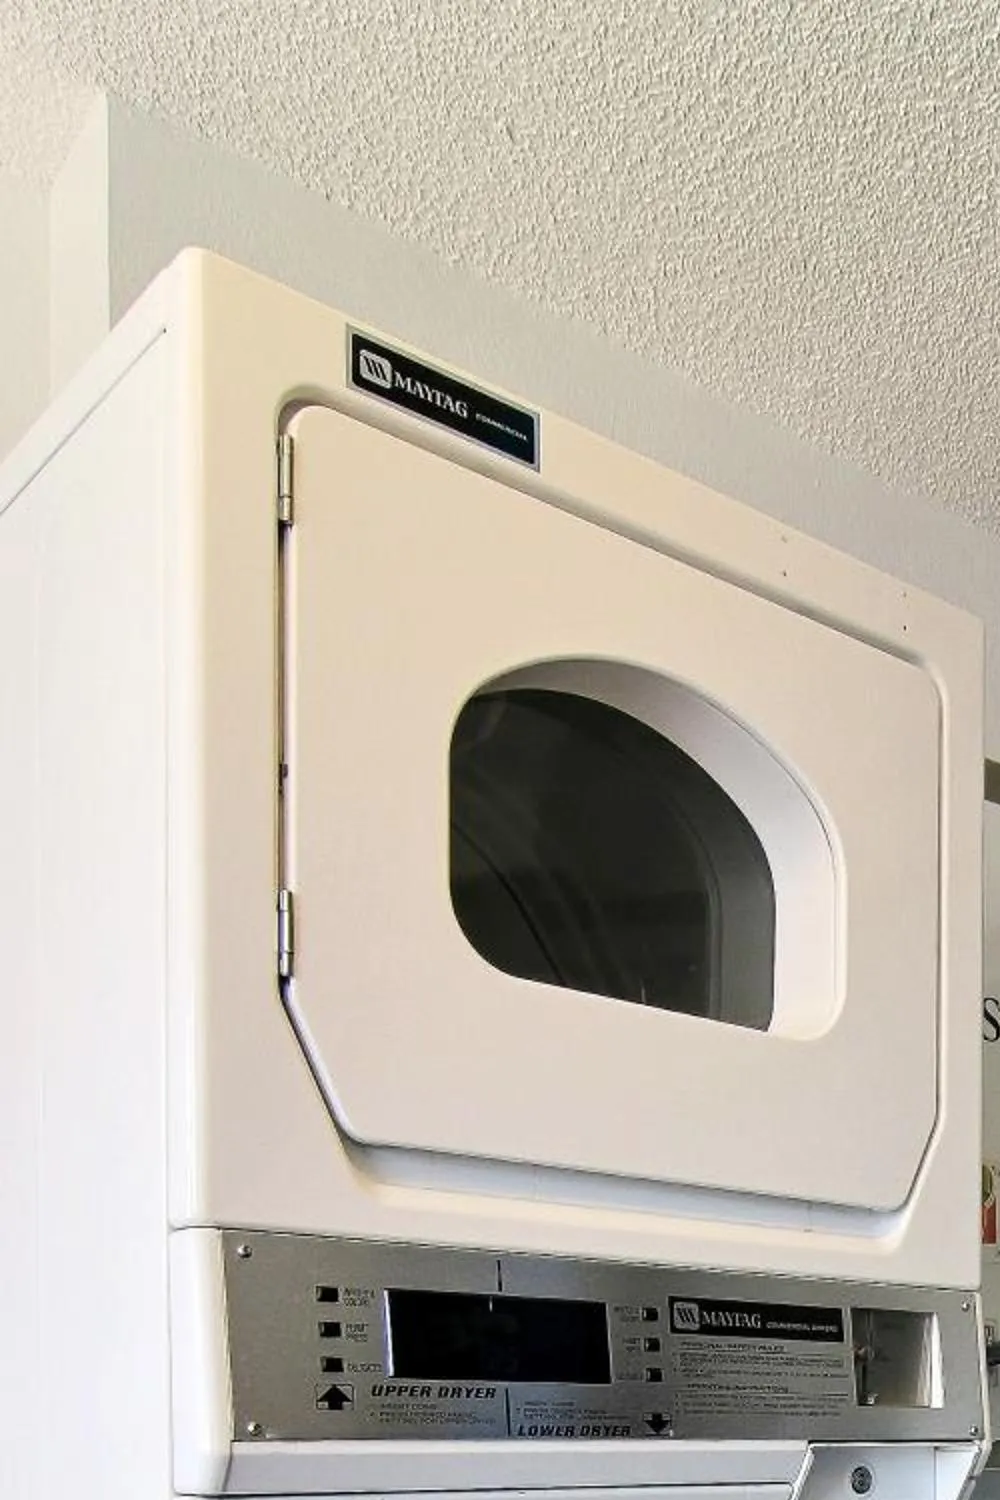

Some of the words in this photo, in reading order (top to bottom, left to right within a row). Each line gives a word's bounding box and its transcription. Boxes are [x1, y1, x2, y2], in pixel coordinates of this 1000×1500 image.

[394, 370, 469, 419] MAYTAG
[701, 1310, 762, 1329] MAYTAG
[371, 1385, 433, 1398] UPPER
[437, 1386, 497, 1399] DRYER
[517, 1424, 576, 1437] LOWER
[579, 1425, 631, 1437] DRYER
